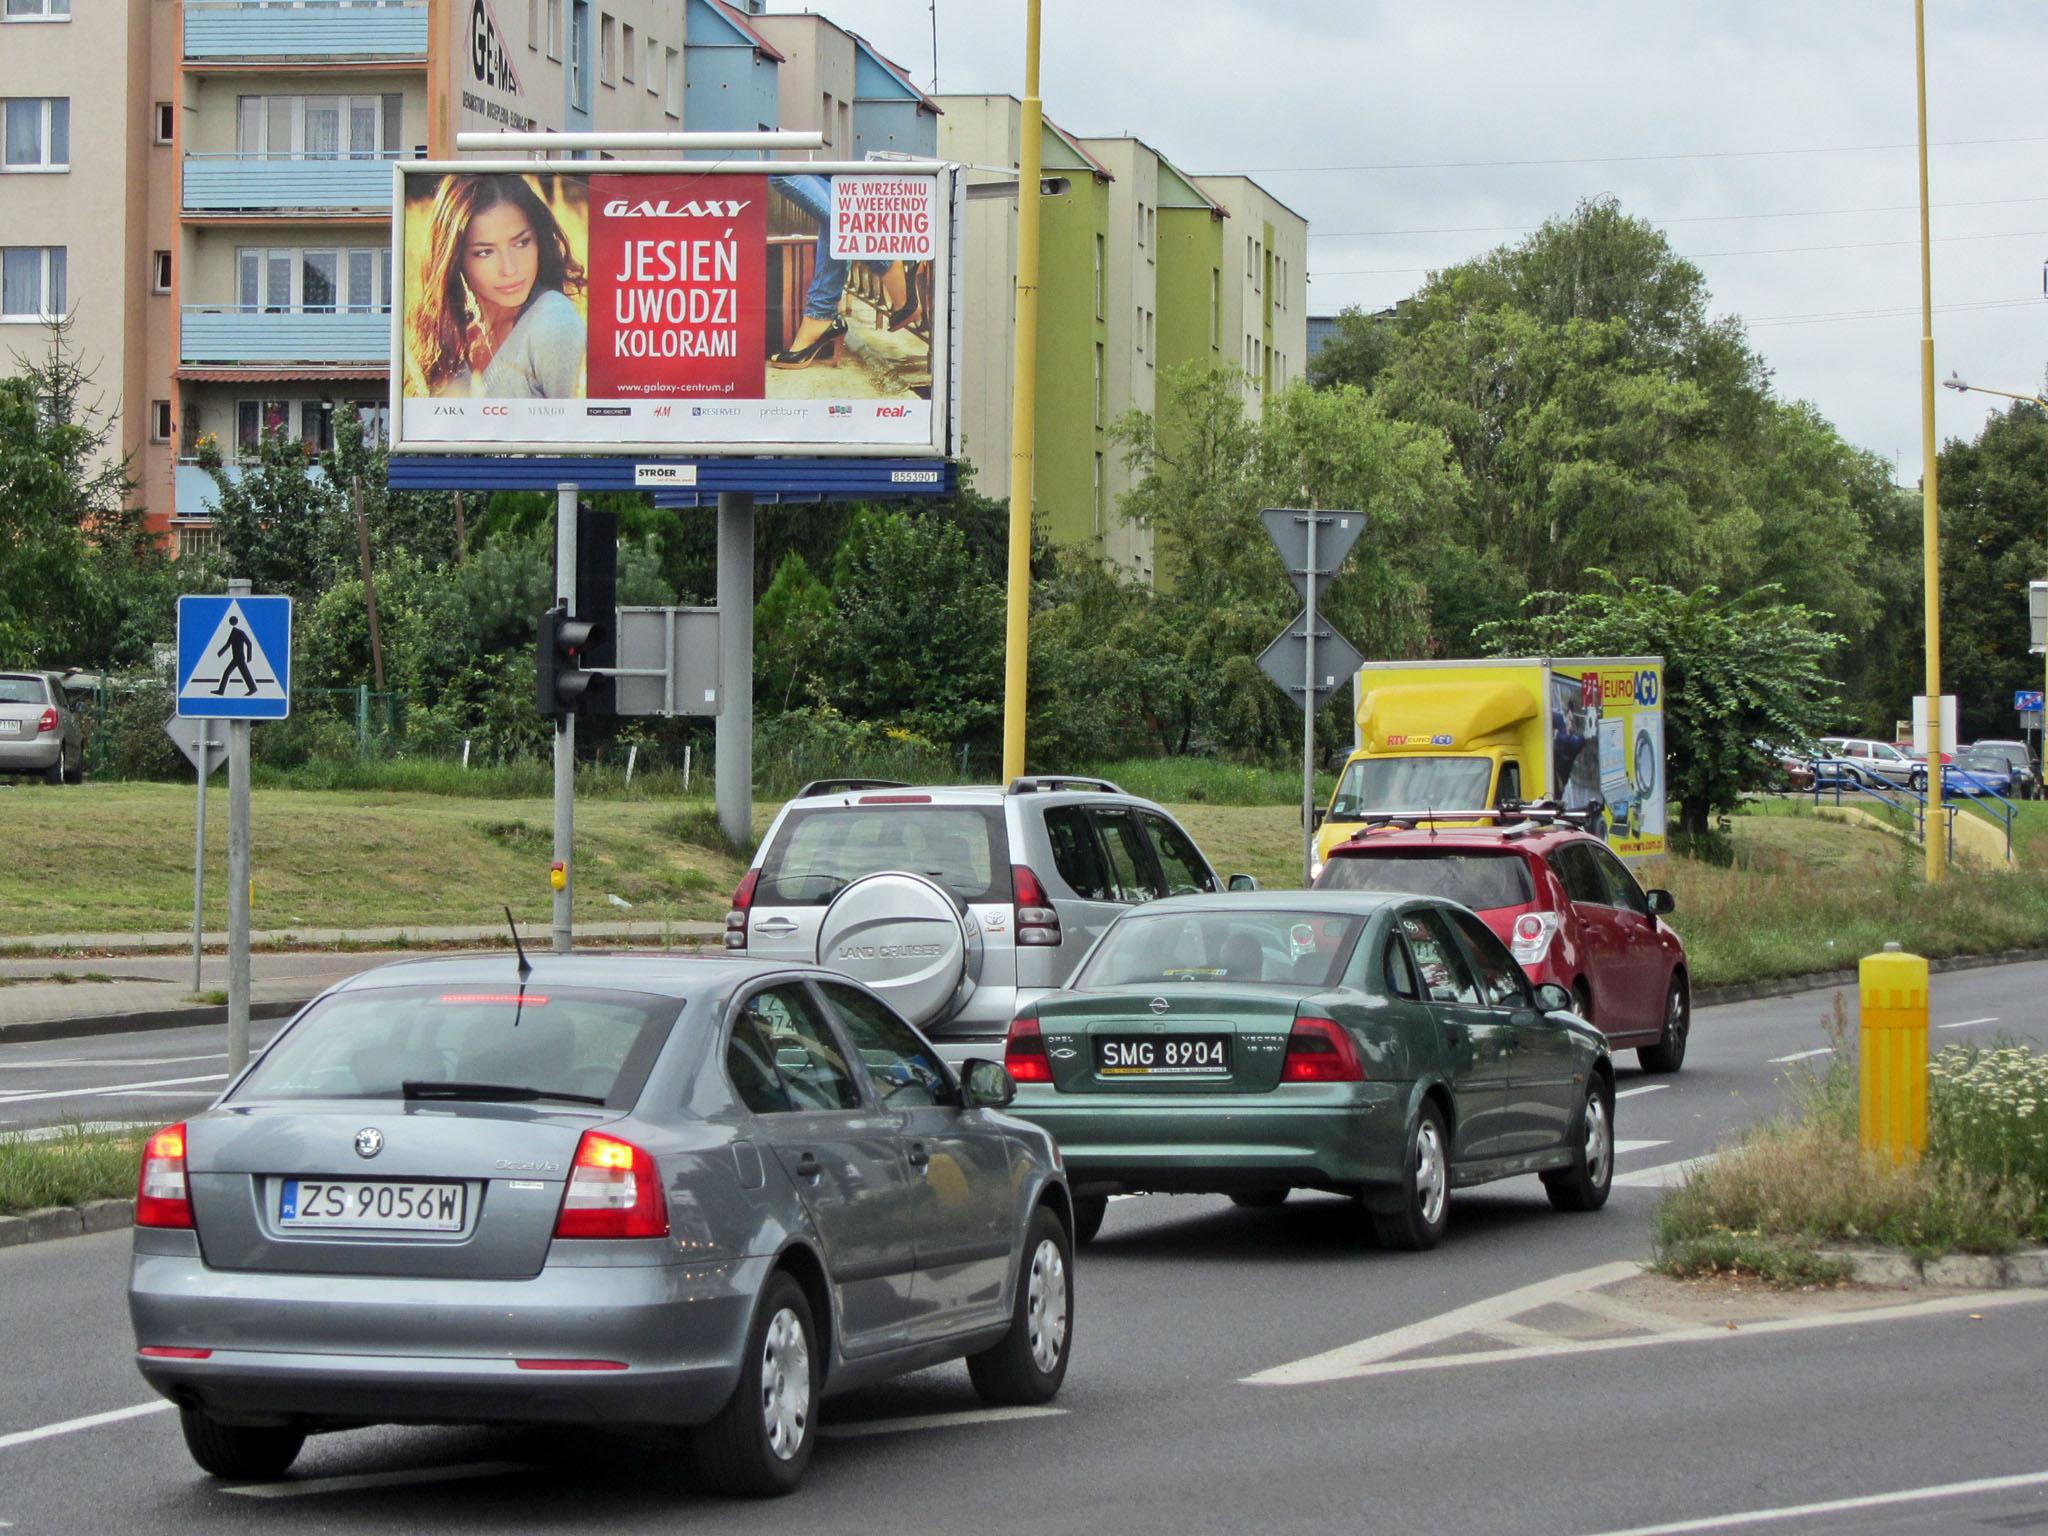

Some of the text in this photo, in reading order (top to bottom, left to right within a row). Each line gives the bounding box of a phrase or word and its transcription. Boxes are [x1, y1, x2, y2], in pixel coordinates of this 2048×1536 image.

[838, 180, 927, 196] WE WRZEŚNIU
[603, 200, 751, 218] GALAXY
[838, 198, 928, 211] W WEEKENDY
[839, 213, 929, 233] PARKING
[838, 236, 930, 254] ZA DARMO
[616, 228, 738, 282] JESIEŃ
[615, 289, 737, 323] UWODZI
[615, 330, 737, 357] KOLORAMI
[617, 382, 735, 394] www.galaxy-centrum.pl
[434, 406, 465, 416] ZARA
[482, 406, 509, 416] CCC
[528, 406, 565, 416] MANGO
[701, 408, 741, 416] RESERVED
[893, 472, 936, 481] 8553901
[1604, 679, 1633, 698] EURO
[1633, 670, 1658, 707] AGD
[1387, 736, 1408, 746] RTV
[1430, 735, 1454, 745] AGD
[840, 943, 945, 960] LAND CRUISER
[1104, 1041, 1223, 1065] SMG 8904
[496, 1159, 560, 1172] Octavia
[284, 1185, 457, 1220] PL ZS 9056W
